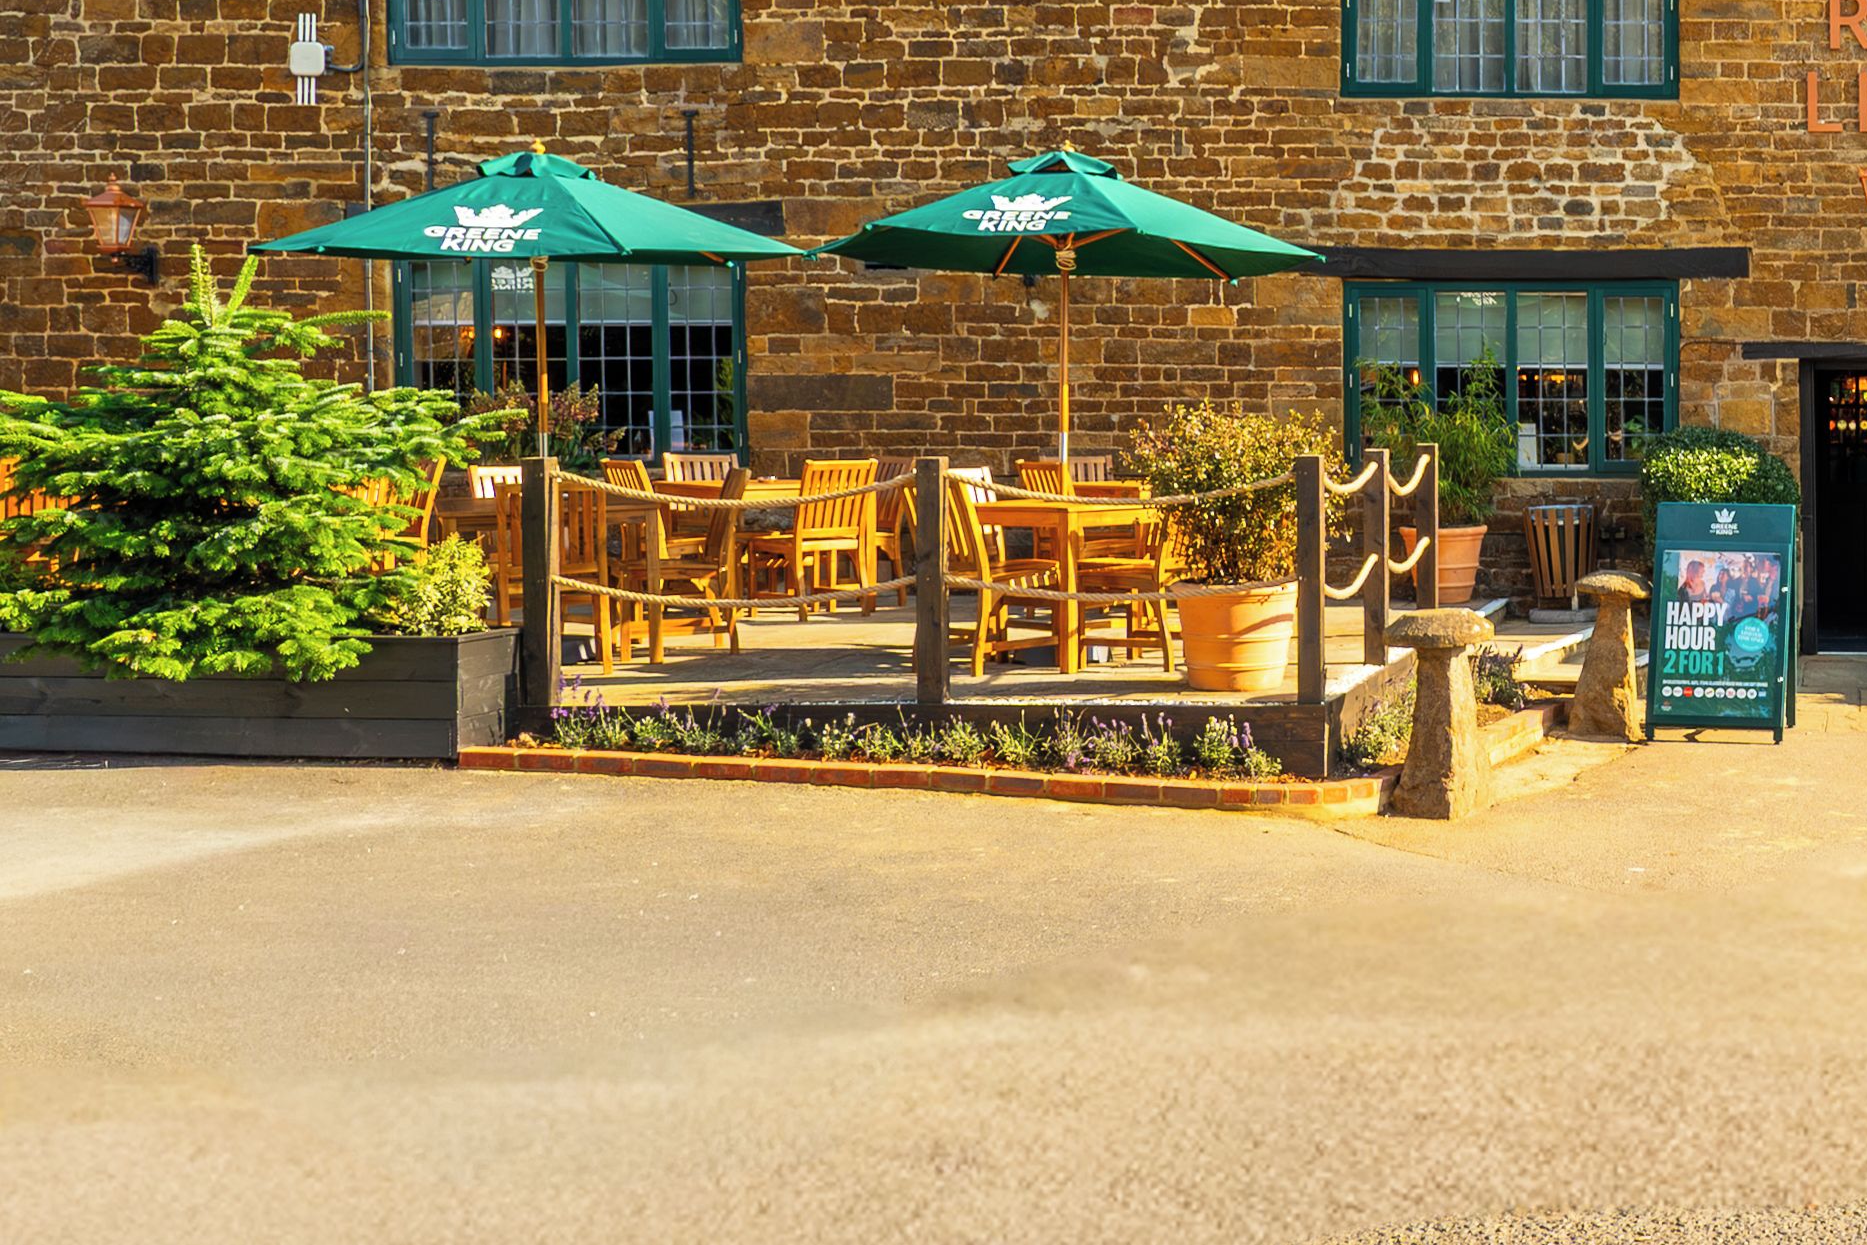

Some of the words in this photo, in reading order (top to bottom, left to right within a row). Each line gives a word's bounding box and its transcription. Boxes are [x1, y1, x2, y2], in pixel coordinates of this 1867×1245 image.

[962, 209, 1072, 221] GREENE
[423, 225, 542, 240] GREENE
[977, 219, 1047, 232] KING
[440, 237, 515, 252] KING
[1666, 601, 1728, 627] HAPPY
[1664, 625, 1716, 651] HOUR
[1663, 650, 1677, 674] 2
[1678, 650, 1714, 675] FOR
[1716, 651, 1725, 677] 1
